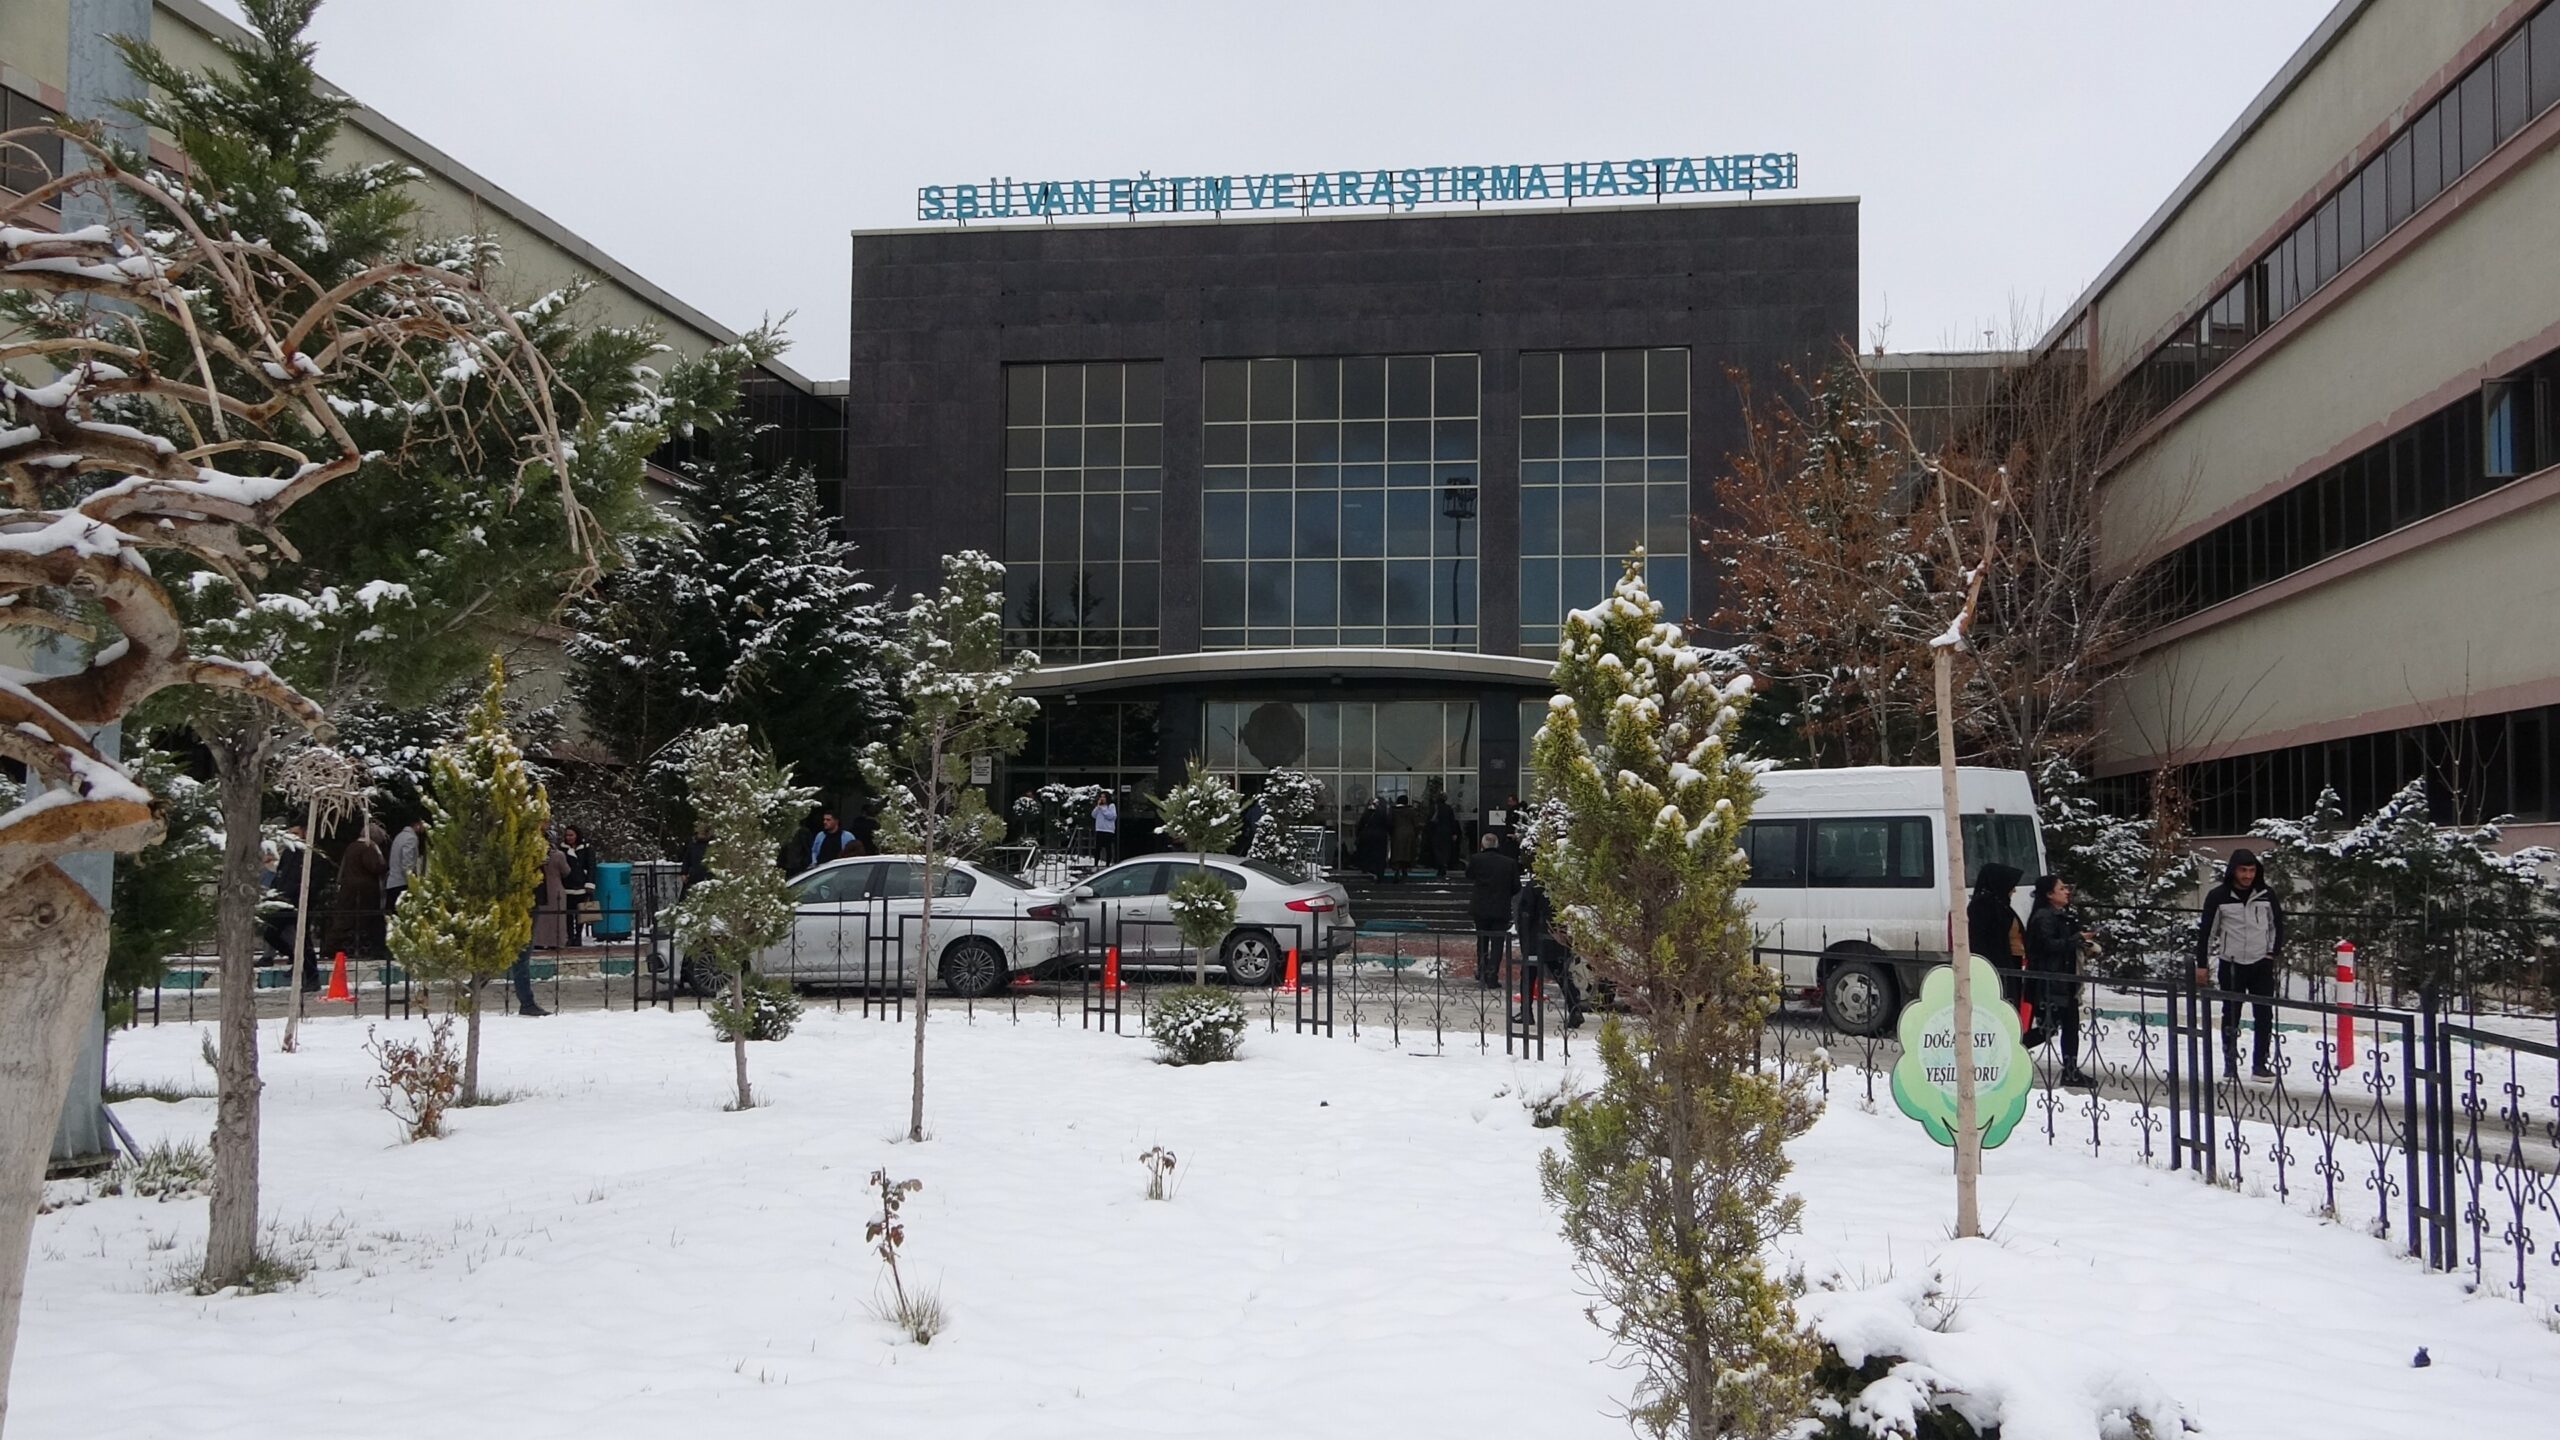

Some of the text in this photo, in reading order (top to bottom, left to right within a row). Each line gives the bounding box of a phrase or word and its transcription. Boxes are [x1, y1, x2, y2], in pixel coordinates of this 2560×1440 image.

[1022, 179, 1096, 217] VAN
[1244, 174, 1295, 209] VE
[1309, 164, 1551, 211] ARAŞTIRMA
[1564, 152, 1796, 197] HASTANESİ
[1973, 1033, 1996, 1048] SEV
[1972, 1066, 1999, 1081] ORU
